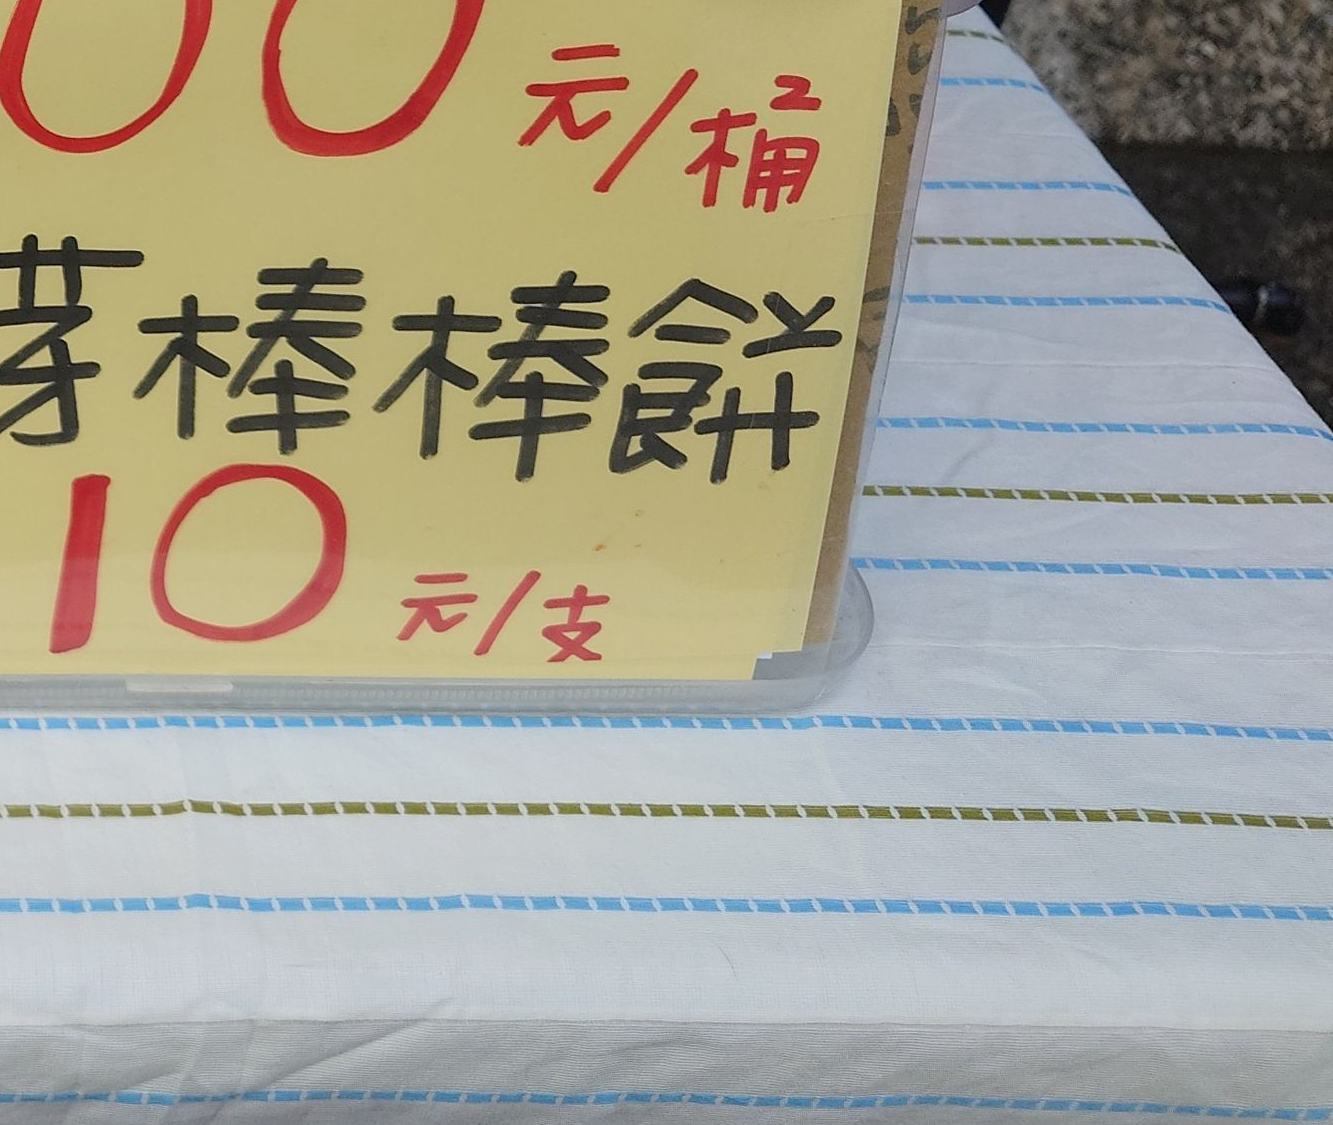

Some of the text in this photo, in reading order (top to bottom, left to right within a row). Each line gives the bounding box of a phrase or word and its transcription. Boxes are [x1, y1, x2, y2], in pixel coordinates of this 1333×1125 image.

[518, 42, 823, 214] 元/桶
[49, 461, 611, 664] 10 元/支
